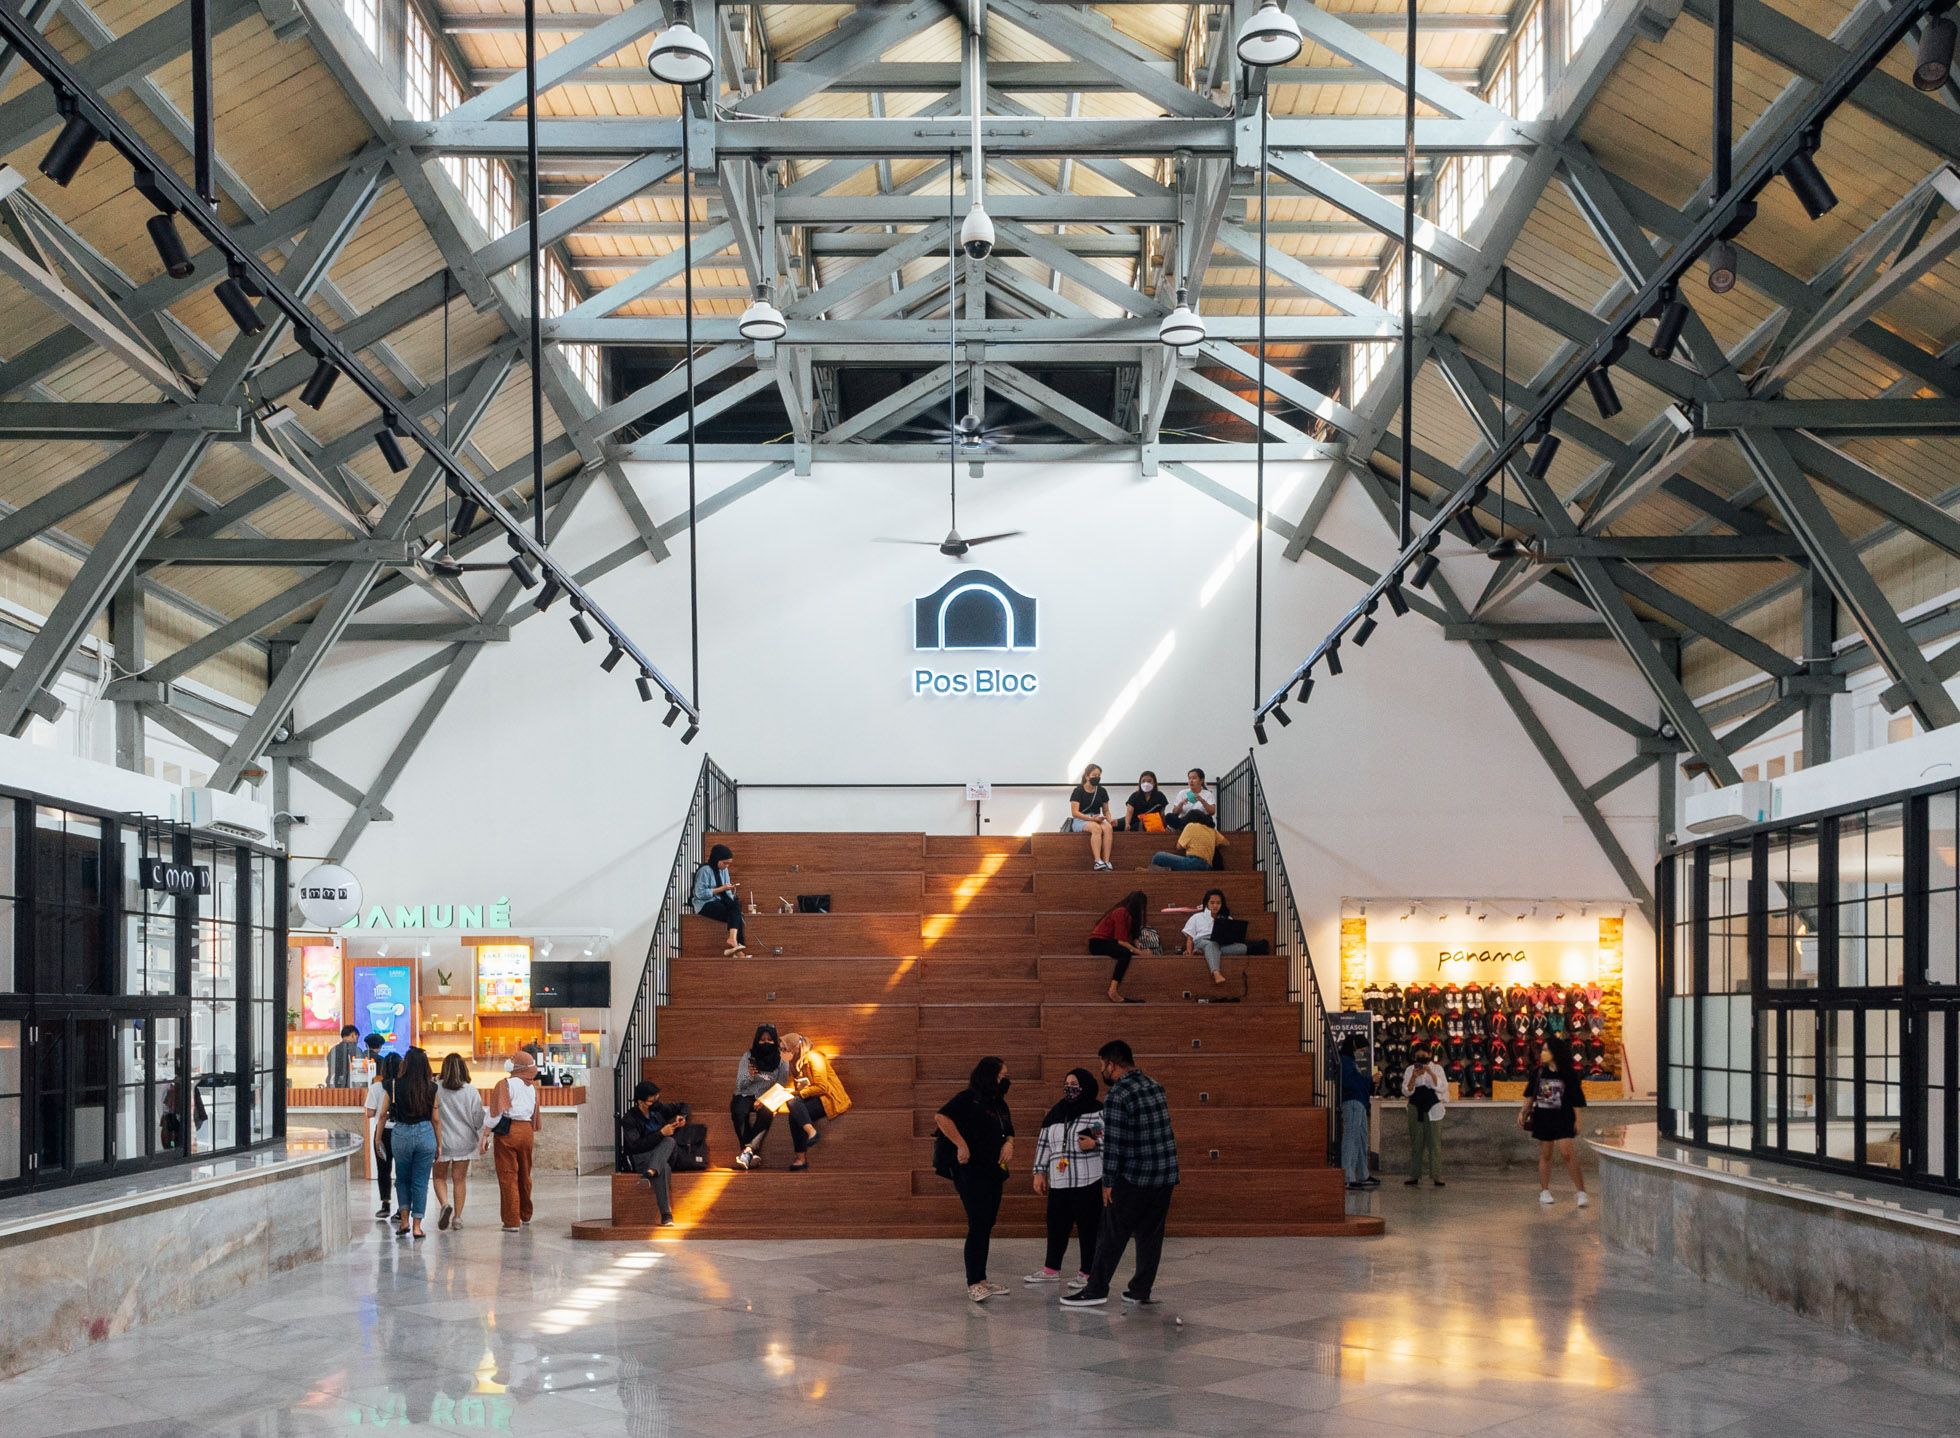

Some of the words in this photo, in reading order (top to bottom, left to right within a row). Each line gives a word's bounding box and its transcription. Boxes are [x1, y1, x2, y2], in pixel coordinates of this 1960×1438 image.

[915, 669, 969, 693] Pos
[975, 669, 1038, 693] Bloc
[1437, 950, 1527, 972] panama
